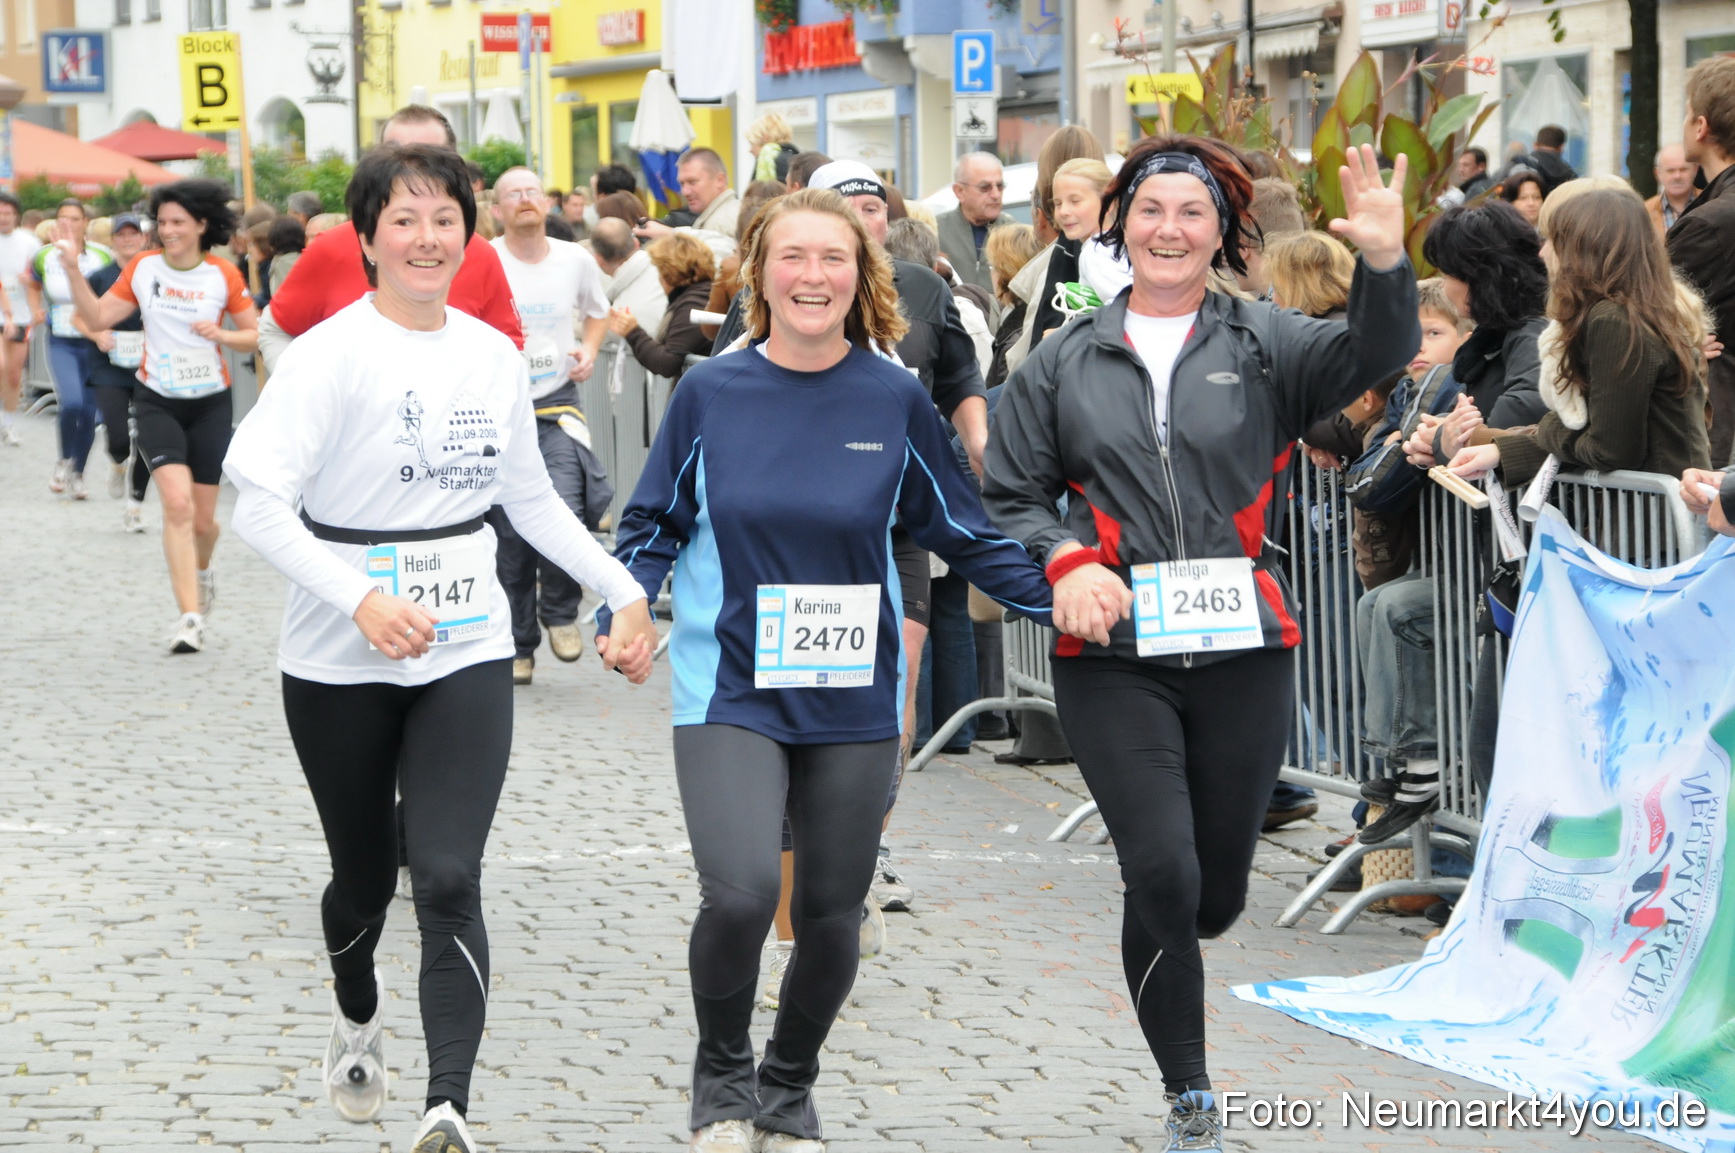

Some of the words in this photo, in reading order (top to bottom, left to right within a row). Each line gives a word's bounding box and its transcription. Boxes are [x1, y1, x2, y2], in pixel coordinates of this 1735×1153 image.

[183, 36, 233, 54] Block
[962, 39, 985, 87] P
[196, 64, 228, 107] B
[166, 288, 205, 299] MERZ
[518, 303, 555, 314] NICEF
[177, 365, 211, 380] 3322
[448, 429, 498, 440] 21.09.2008
[400, 465, 421, 483] 9.
[404, 552, 441, 573] Heidi
[1168, 559, 1209, 580] Helga
[408, 577, 475, 608] 2147
[1173, 587, 1242, 615] 2463
[795, 597, 842, 615] Karina
[449, 621, 489, 636] PFLEIDERER
[766, 625, 773, 638] D
[793, 626, 865, 651] 2470
[829, 670, 871, 681] PFLEIDERER
